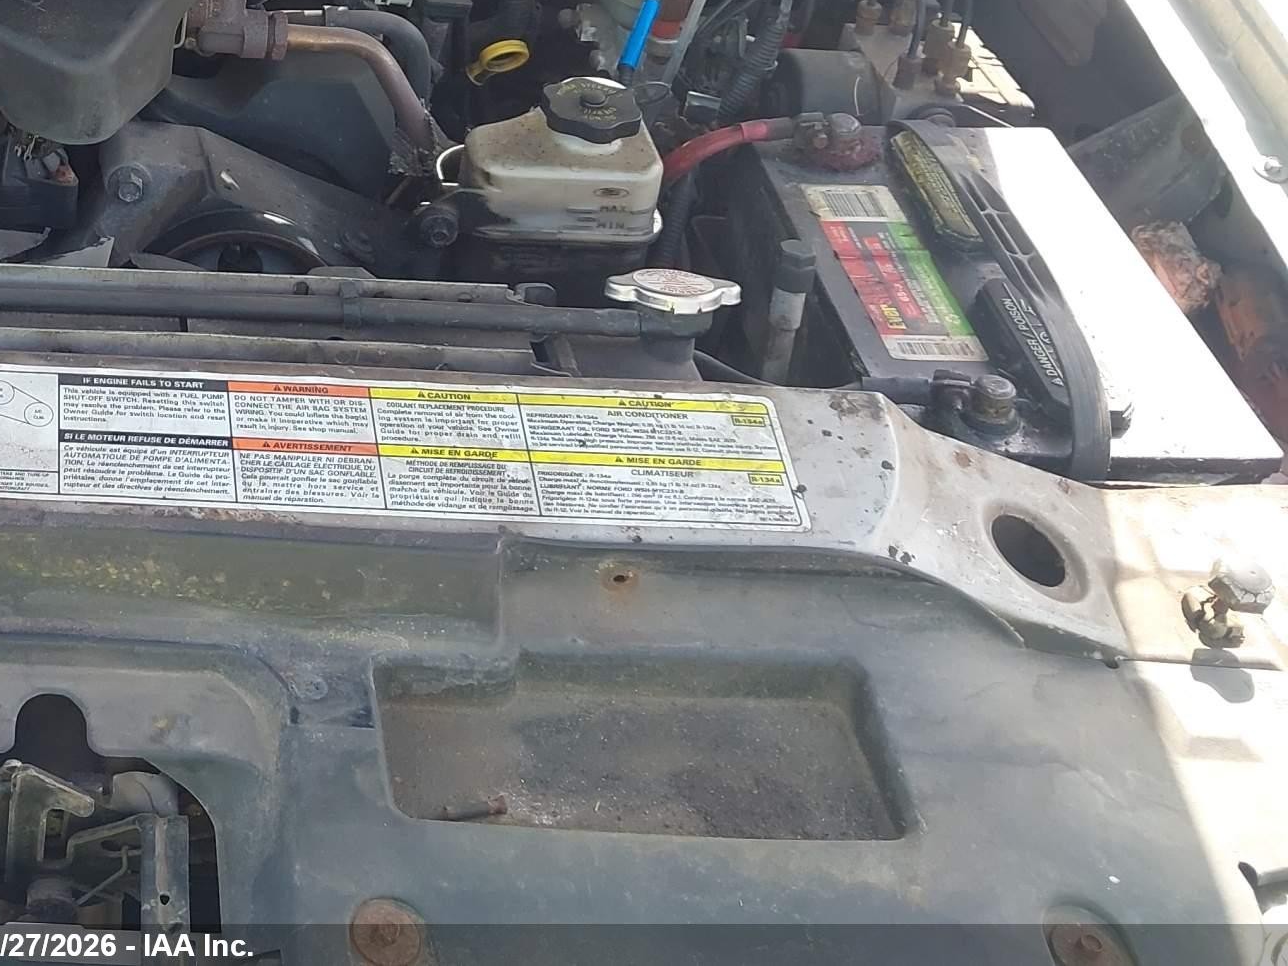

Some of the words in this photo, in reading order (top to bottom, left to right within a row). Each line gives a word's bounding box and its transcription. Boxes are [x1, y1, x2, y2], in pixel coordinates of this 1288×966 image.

[1000, 297, 1031, 331] POISON
[1025, 338, 1058, 377] DANGER
[118, 390, 151, 398] equipped
[428, 392, 470, 400] CAUTION
[142, 398, 178, 406] Resetting
[628, 400, 672, 408] CAUTION
[124, 404, 156, 412] problem.
[625, 411, 688, 419] CONDITIONER
[280, 418, 323, 426] inoperative
[128, 436, 161, 444] REFUSE
[178, 438, 229, 446] DÉMARRER
[273, 442, 353, 452] AVERTISSEMENT
[406, 459, 437, 467] MÉTHODE
[668, 458, 702, 466] GARDE
[630, 470, 694, 478] CLIMATISEUR
